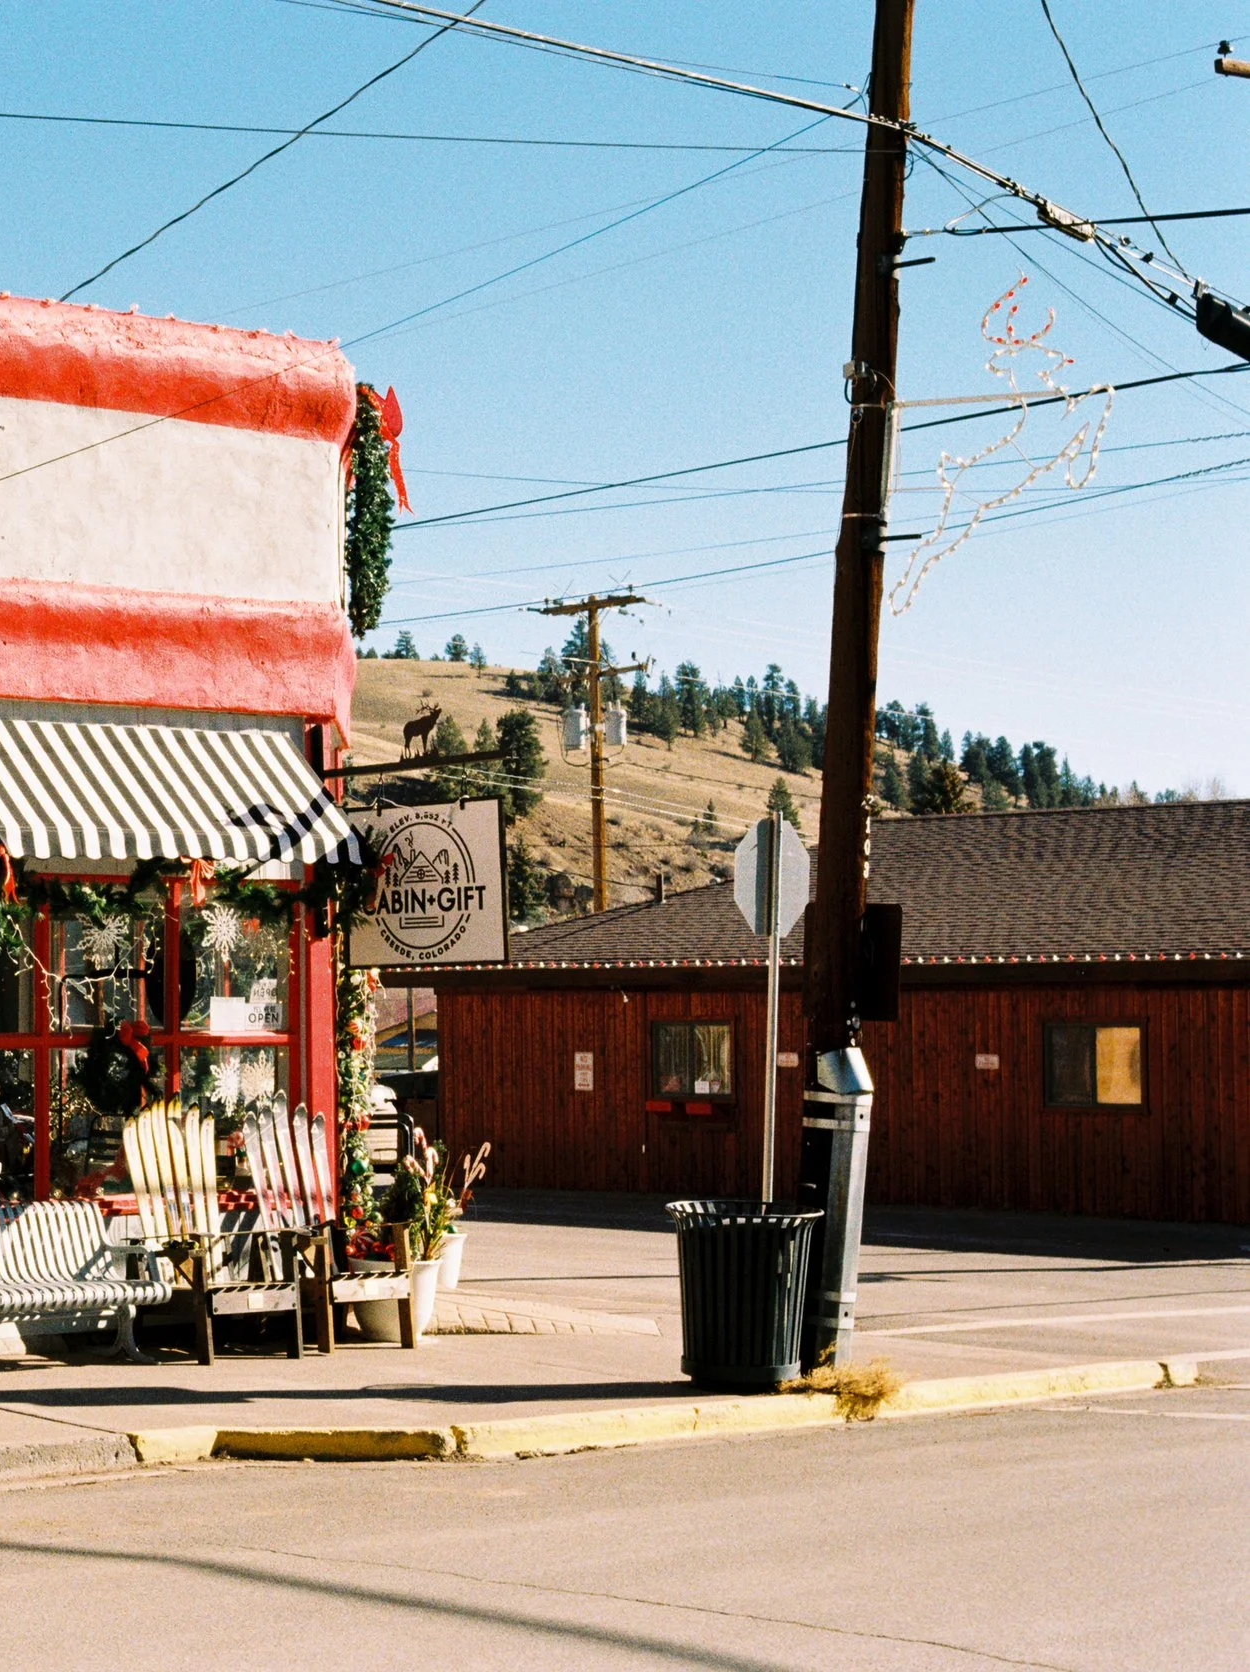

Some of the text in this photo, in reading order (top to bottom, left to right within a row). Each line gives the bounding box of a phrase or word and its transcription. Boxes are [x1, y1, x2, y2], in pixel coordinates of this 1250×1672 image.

[389, 814, 412, 834] ELEV.
[380, 925, 466, 960] CREEDE, COLORADO
[248, 1012, 279, 1023] OPEN
